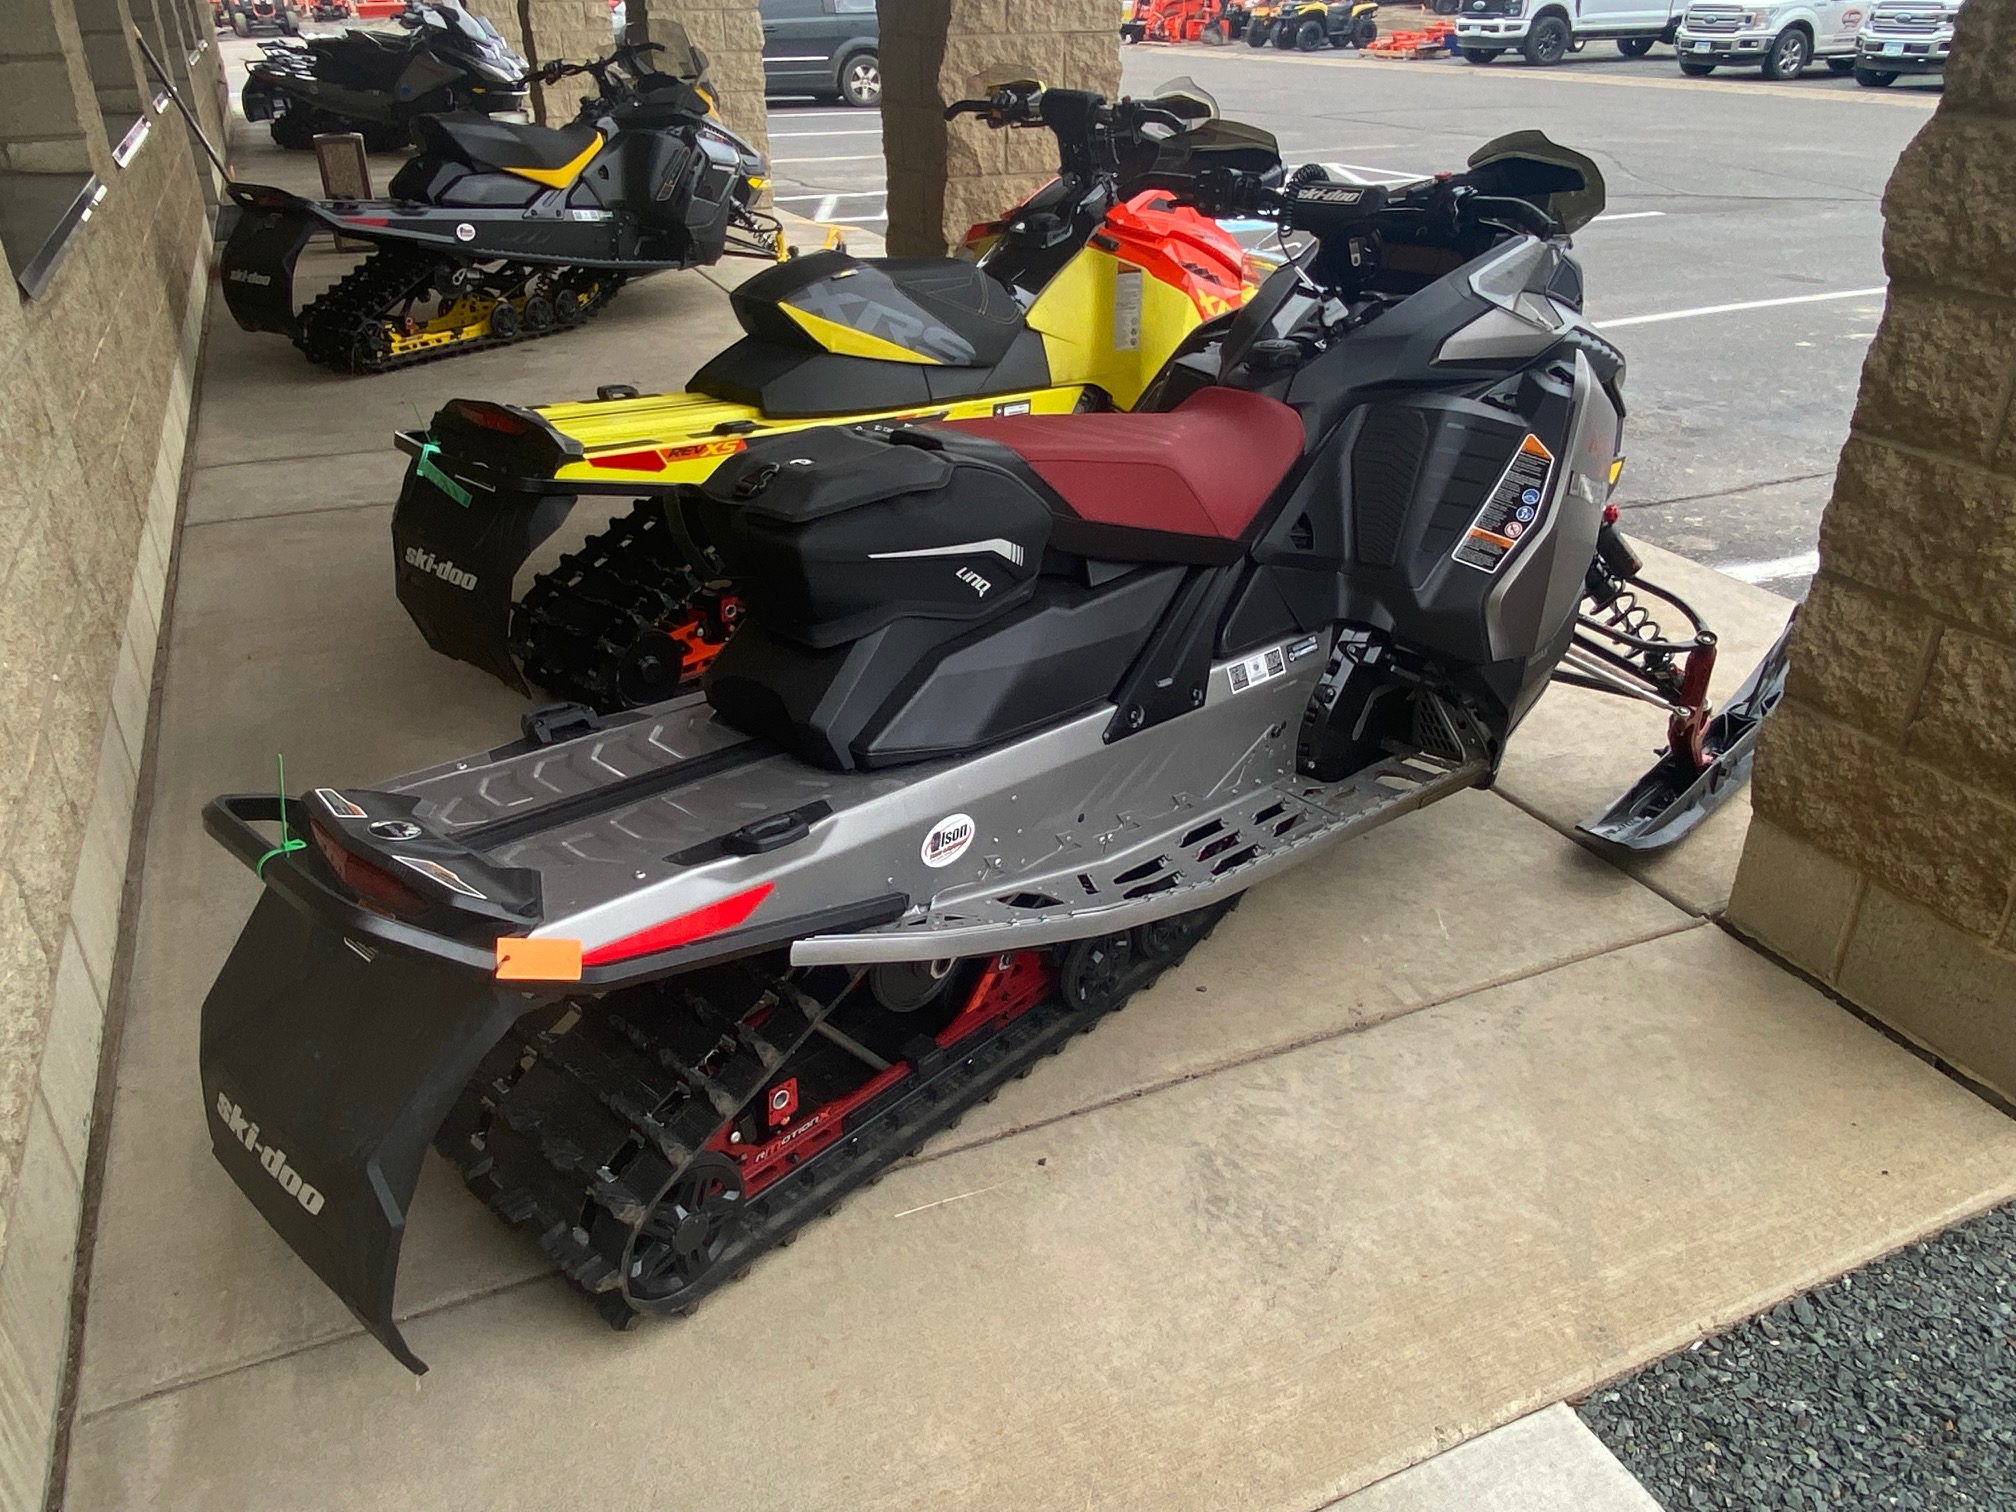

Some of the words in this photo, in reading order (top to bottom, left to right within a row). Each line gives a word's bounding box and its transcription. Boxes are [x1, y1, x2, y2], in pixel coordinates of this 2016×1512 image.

[1297, 188, 1360, 202] ski-doo
[797, 282, 977, 363] XRS
[405, 547, 478, 591] ski-doo
[217, 1091, 326, 1216] ski-doo
